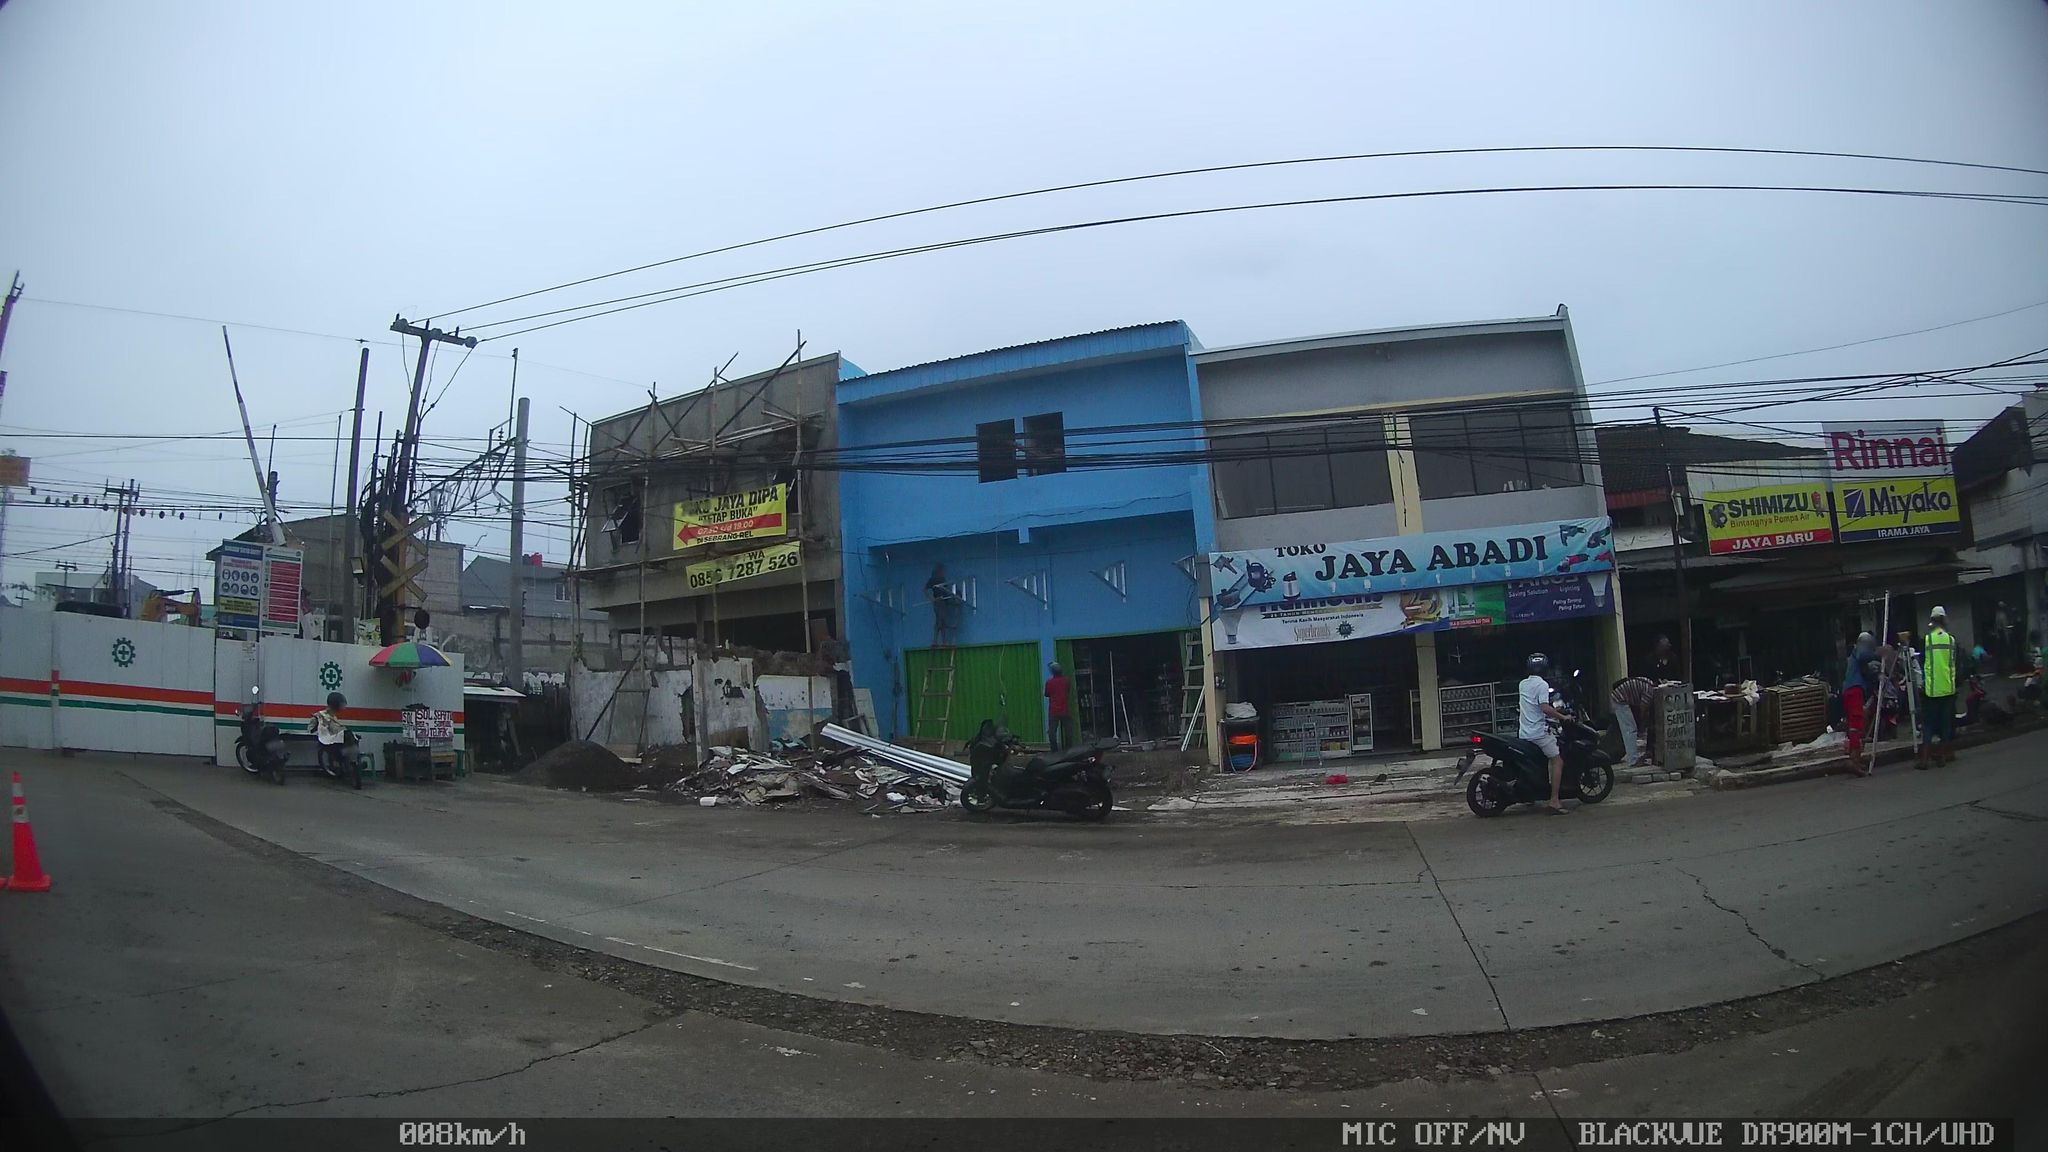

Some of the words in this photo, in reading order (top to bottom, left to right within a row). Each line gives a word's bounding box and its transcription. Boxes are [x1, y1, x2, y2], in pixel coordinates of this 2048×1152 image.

[1830, 427, 1948, 471] Rinnai
[714, 492, 744, 511] JAYA
[748, 486, 779, 506] DIPA
[1728, 492, 1809, 518] SHIMIZU
[1870, 482, 1951, 523] Miyako
[1774, 515, 1798, 524] Pompa
[1800, 513, 1810, 521] Air
[1732, 536, 1772, 550] JAYA
[1775, 532, 1814, 545] BARU
[1878, 527, 1908, 538] IRAMA
[1909, 525, 1931, 535] JAYA
[748, 550, 766, 561] WA
[1274, 543, 1327, 558] TOKO
[1315, 549, 1416, 581] JAYA
[1427, 536, 1548, 571] ABADI
[768, 551, 798, 571] 526
